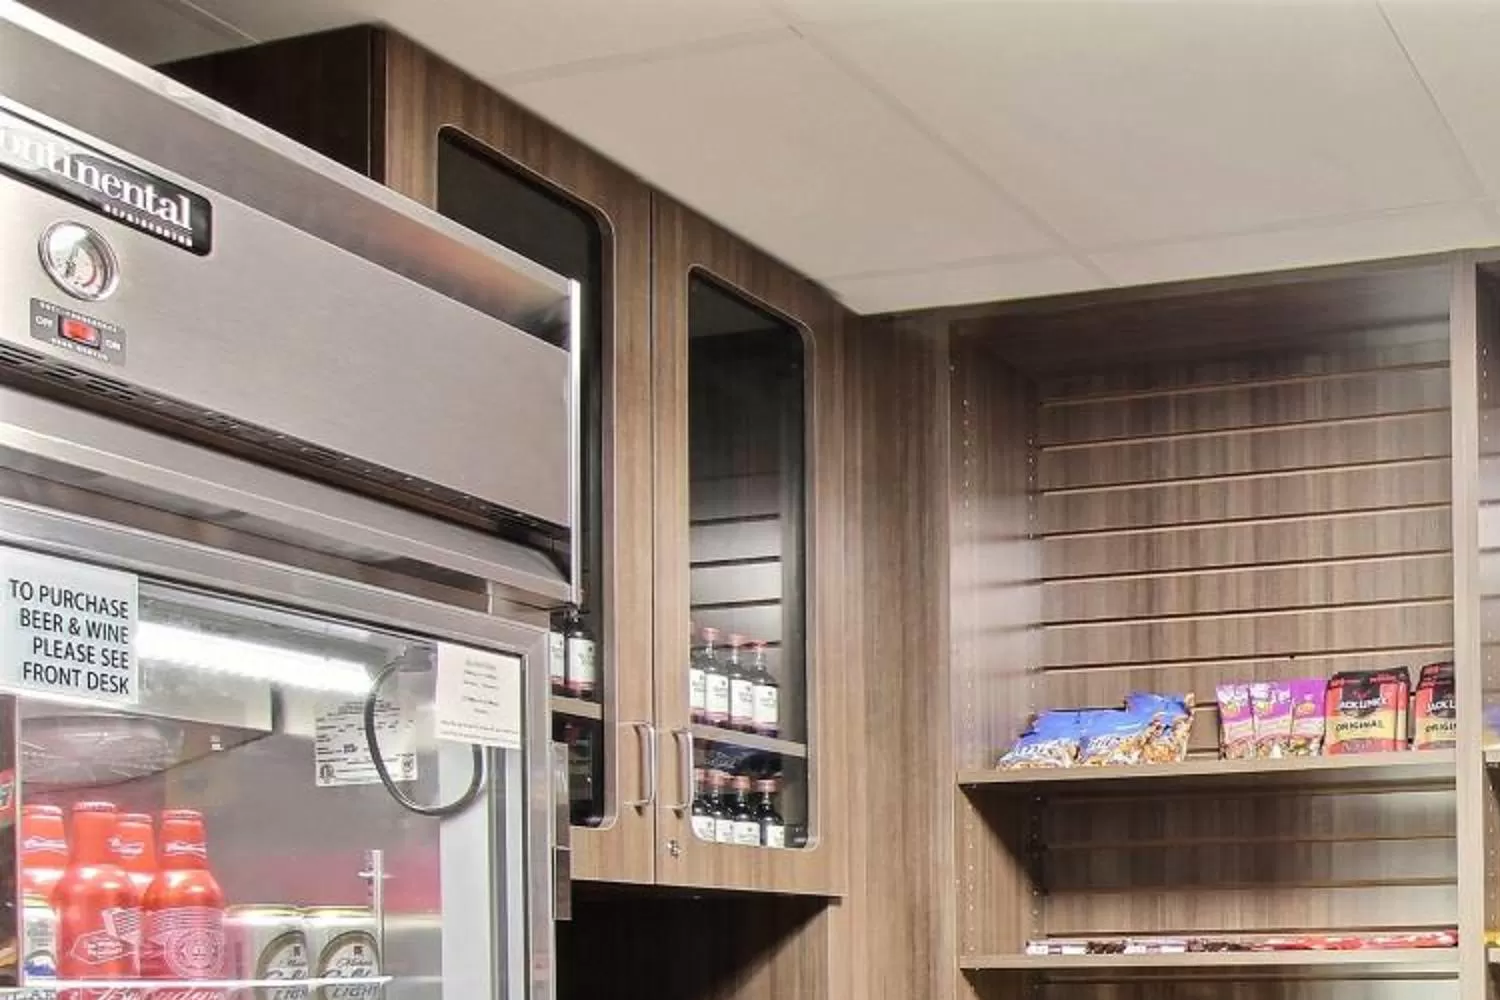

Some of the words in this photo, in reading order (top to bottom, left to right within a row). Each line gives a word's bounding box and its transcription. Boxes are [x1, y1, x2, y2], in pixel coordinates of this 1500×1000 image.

[0, 122, 193, 232] ontinental
[9, 578, 33, 601] TO
[39, 584, 129, 620] PURCHASE
[20, 607, 63, 633] BEER
[69, 617, 81, 636] &
[85, 619, 129, 645] WINE
[33, 635, 96, 665] PLEASE
[101, 647, 129, 670] SEE
[23, 660, 81, 687] FRONT
[87, 671, 129, 695] DESK
